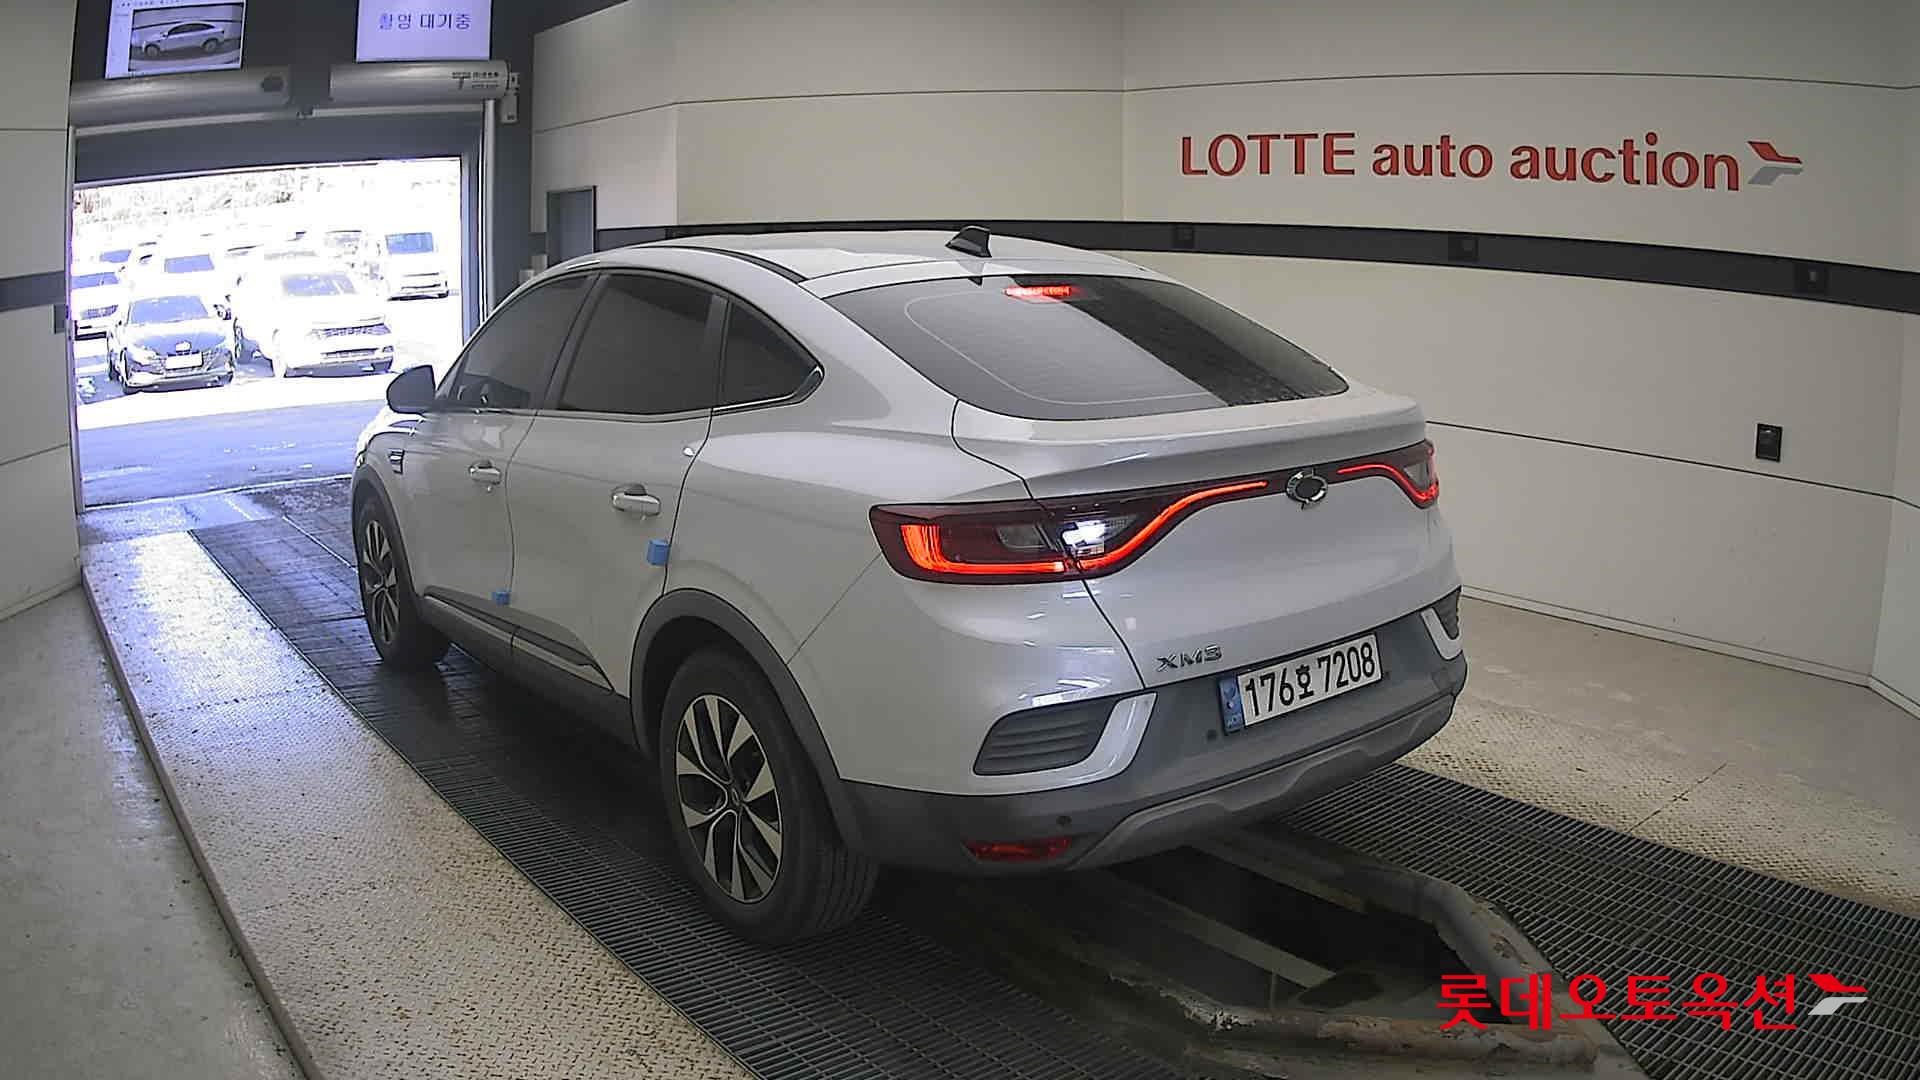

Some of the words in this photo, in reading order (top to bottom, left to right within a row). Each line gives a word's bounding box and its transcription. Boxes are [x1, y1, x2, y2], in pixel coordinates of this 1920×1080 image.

[420, 13, 471, 30] 대기중
[1181, 132, 1356, 177] LOTTE
[1371, 134, 1494, 179] auto
[1509, 132, 1741, 192] auction
[1157, 645, 1222, 671] XM3
[1244, 664, 1315, 717] 176호
[1317, 642, 1376, 693] 7208
